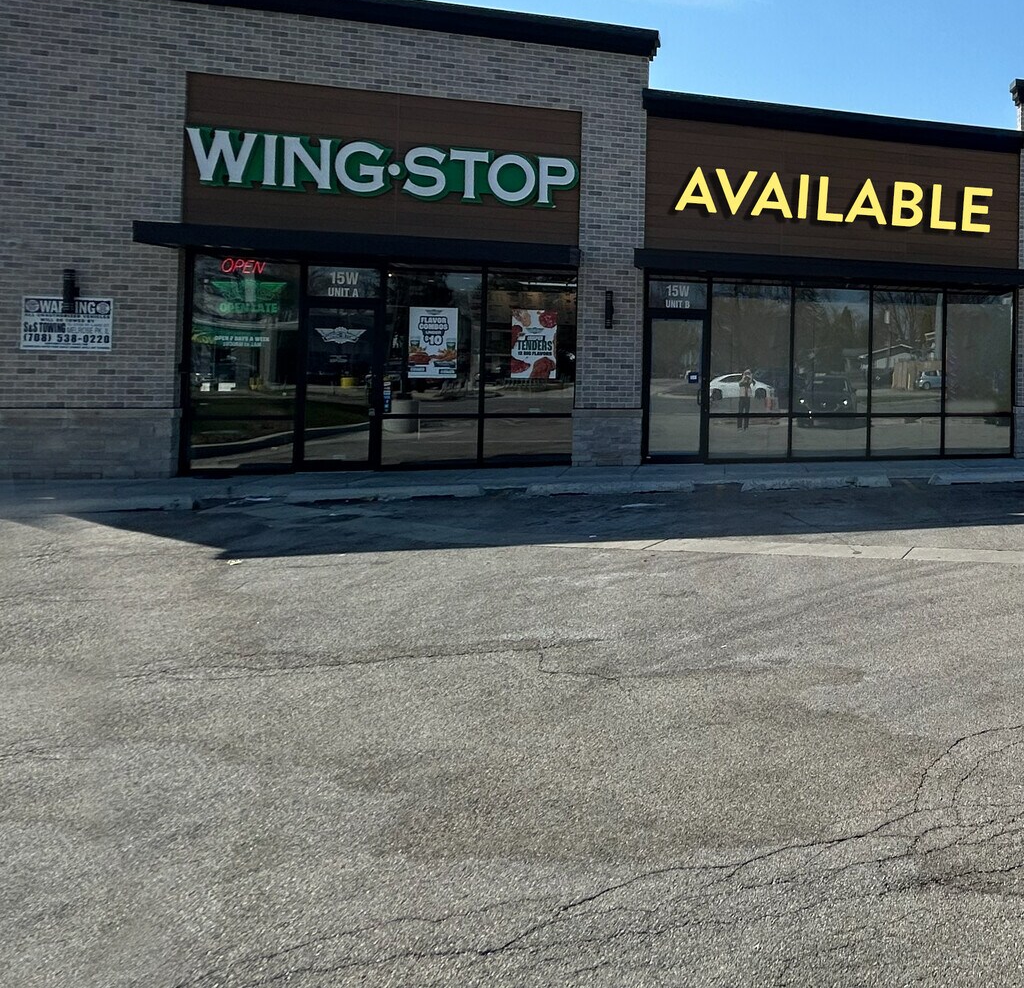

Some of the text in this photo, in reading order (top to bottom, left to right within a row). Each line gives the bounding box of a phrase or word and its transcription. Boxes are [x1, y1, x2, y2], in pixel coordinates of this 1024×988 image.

[674, 166, 993, 233] AVAILABLE
[221, 258, 266, 274] OPEN
[330, 272, 359, 285] 15W
[327, 287, 359, 298] UNIT A
[666, 284, 690, 297] 15W
[39, 300, 97, 314] WAING
[219, 303, 278, 313] OPEN LATE
[665, 299, 690, 309] UNIT B
[24, 322, 38, 333] S&S
[39, 322, 66, 333] TOWING
[23, 333, 110, 343] (708) 538-0220
[424, 335, 443, 345] $10
[517, 340, 552, 351] TENDERS
